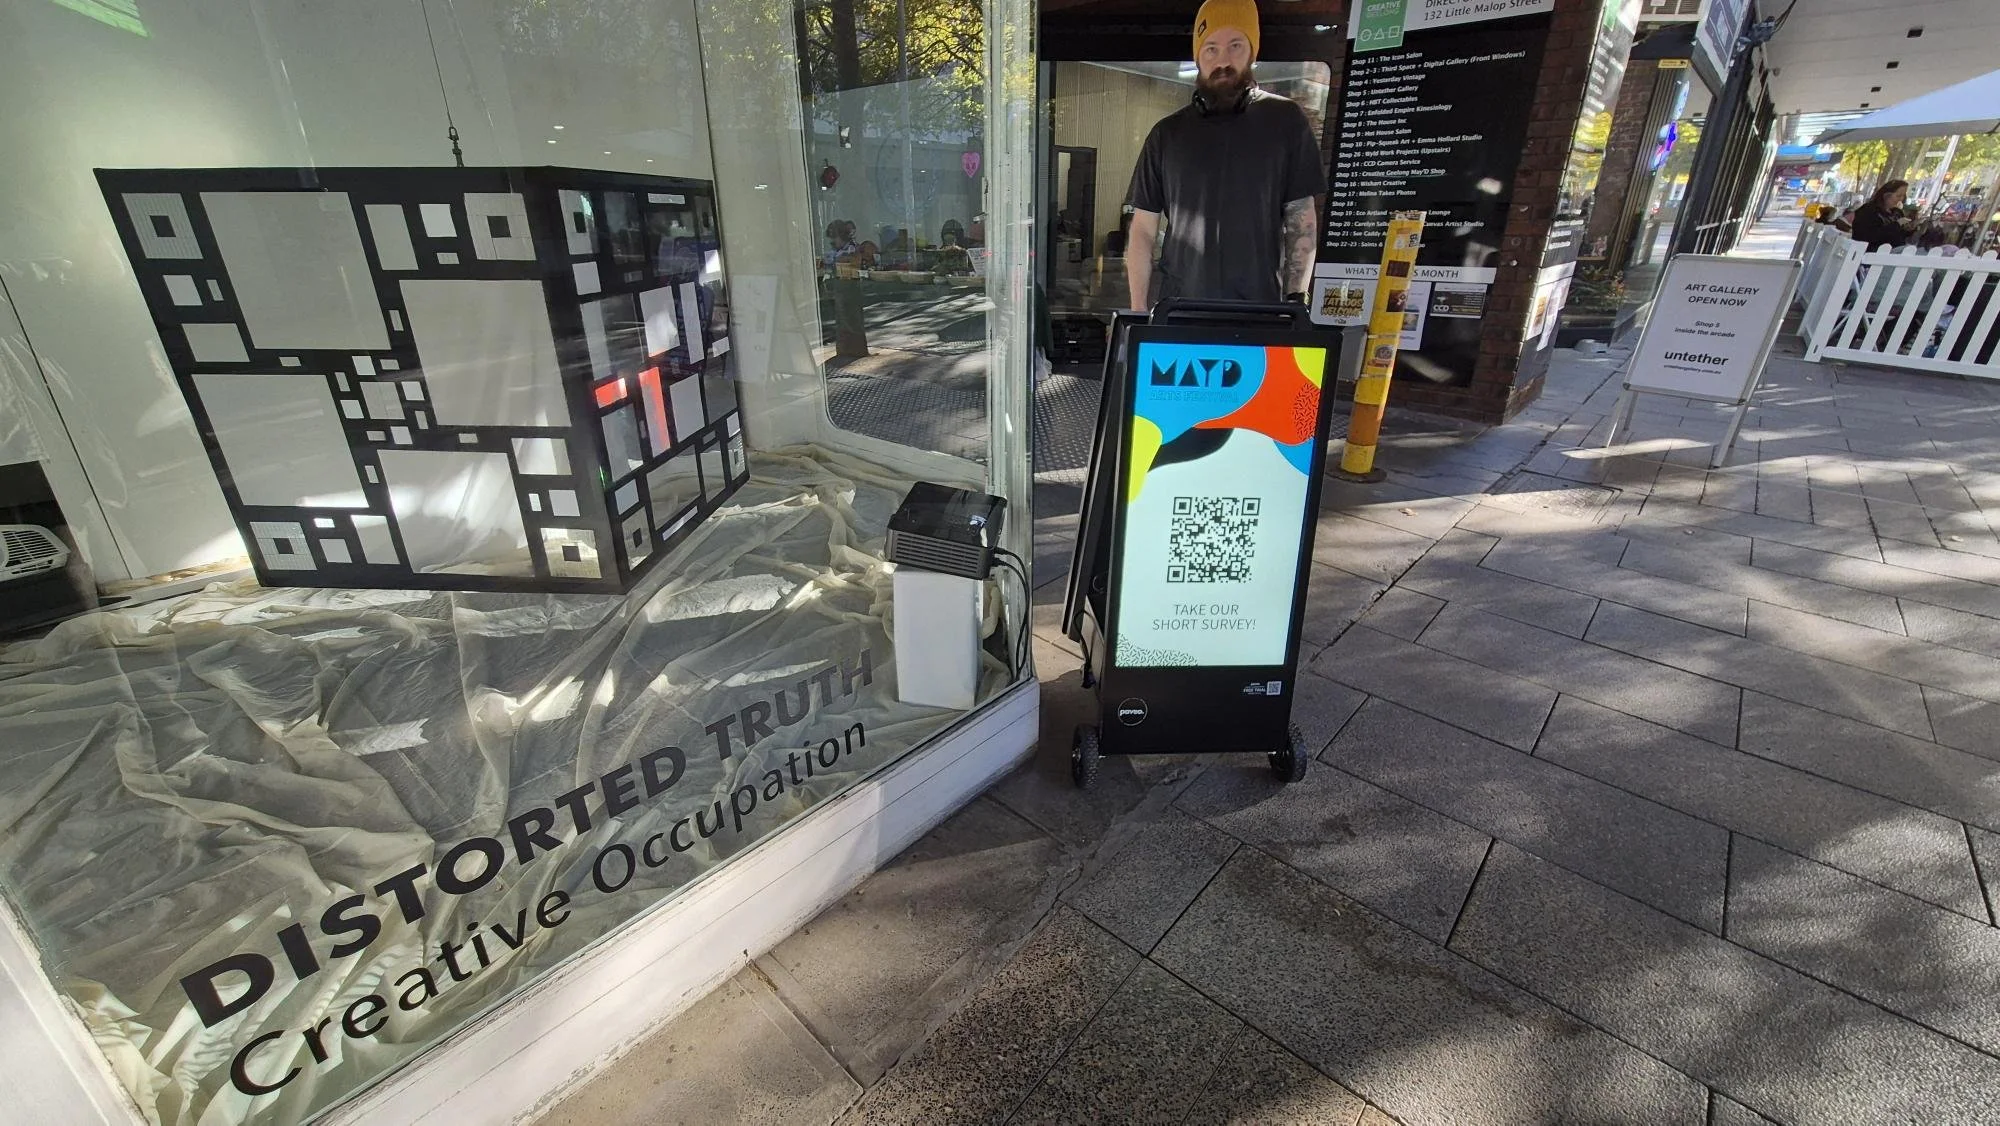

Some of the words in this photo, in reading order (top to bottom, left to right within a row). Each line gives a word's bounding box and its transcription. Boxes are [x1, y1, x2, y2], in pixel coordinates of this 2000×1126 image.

[1367, 1, 1400, 12] CREATIVE
[1425, 0, 1472, 8] DIREC
[1425, 10, 1441, 20] 132
[1446, 7, 1471, 17] Little
[1474, 1, 1506, 13] Malop
[1423, 60, 1445, 68] Digital
[1446, 57, 1469, 65] Gallery
[1372, 75, 1402, 84] Yesterday
[1462, 133, 1483, 141] Studio
[1386, 169, 1410, 177] Geelong
[1428, 209, 1452, 217] Lounge
[1463, 220, 1485, 228] Studio
[1345, 267, 1378, 275] WHAT'S
[1421, 270, 1460, 278] MONTH
[1324, 287, 1364, 299] WA-IN
[1685, 283, 1708, 292] ART
[1709, 285, 1760, 295] GALLERY
[1688, 295, 1718, 305] OPEN
[1719, 298, 1748, 307] NOW
[1695, 320, 1714, 328] Shop
[1664, 351, 1729, 366] untether
[1174, 604, 1207, 616] TAKE
[1210, 604, 1239, 616] OUR
[1152, 618, 1199, 631] SHORT
[1201, 618, 1257, 630] SURVEY!
[180, 747, 687, 1031] DISTORTED
[705, 650, 874, 761] TRUTH
[229, 889, 573, 1097] Creative
[592, 720, 867, 894] Occupation
